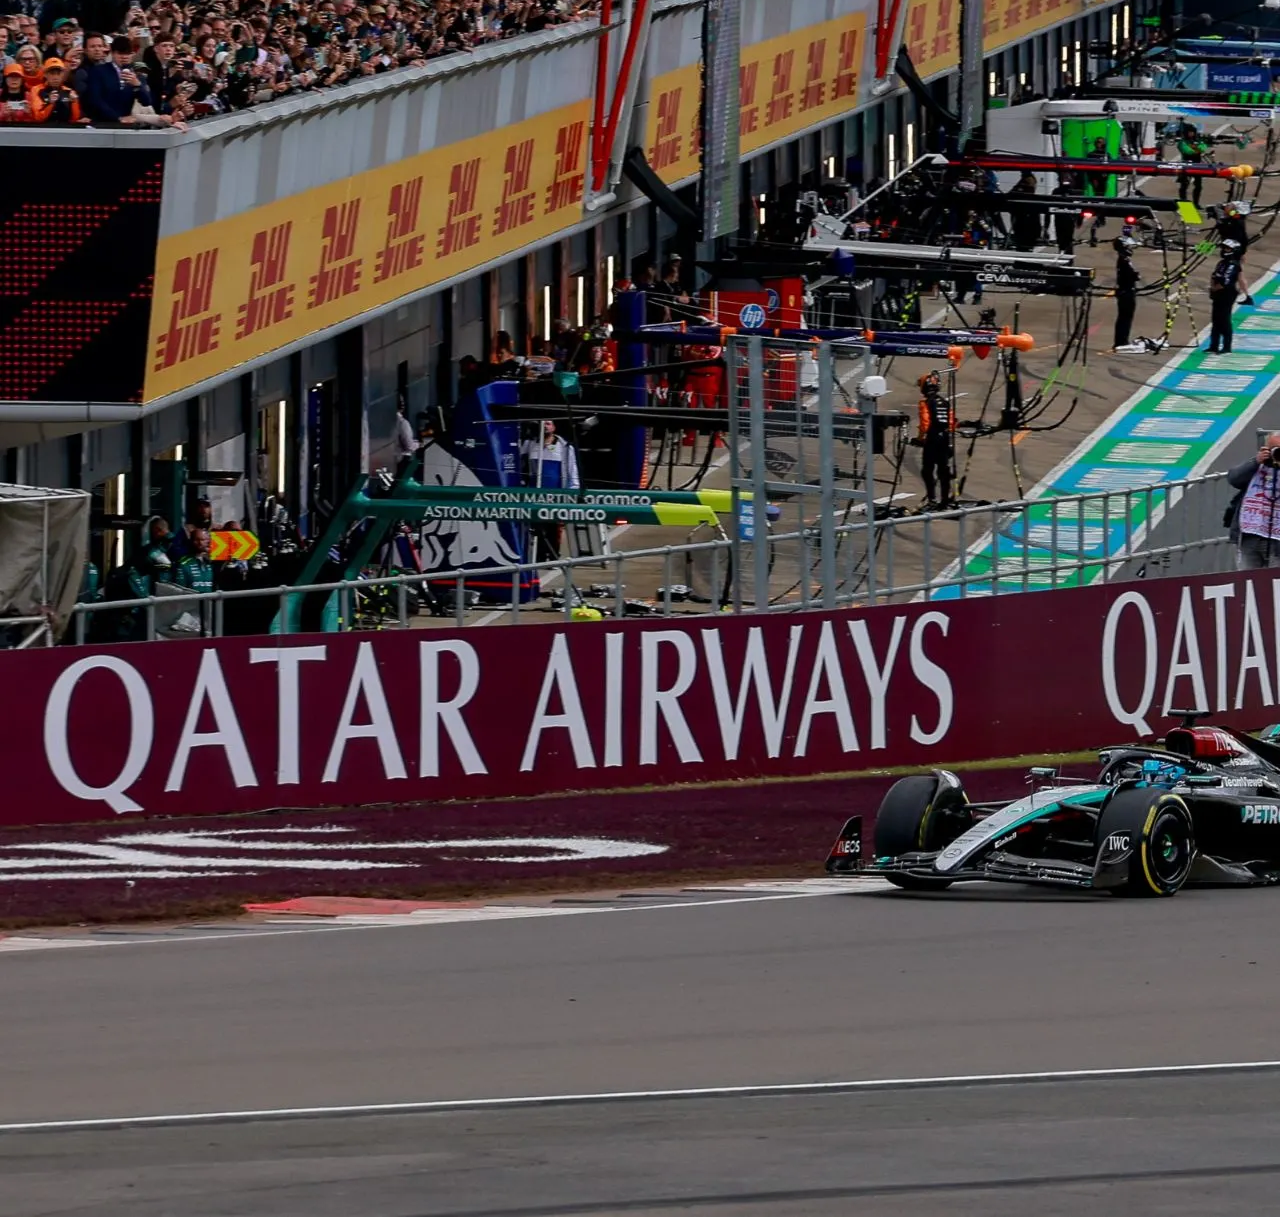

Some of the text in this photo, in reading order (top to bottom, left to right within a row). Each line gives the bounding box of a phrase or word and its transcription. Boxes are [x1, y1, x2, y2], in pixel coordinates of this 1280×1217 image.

[424, 506, 607, 521] ASTON MARTIN aramco
[43, 609, 955, 814] QATAR AIRWAYS
[1109, 834, 1130, 851] IWC
